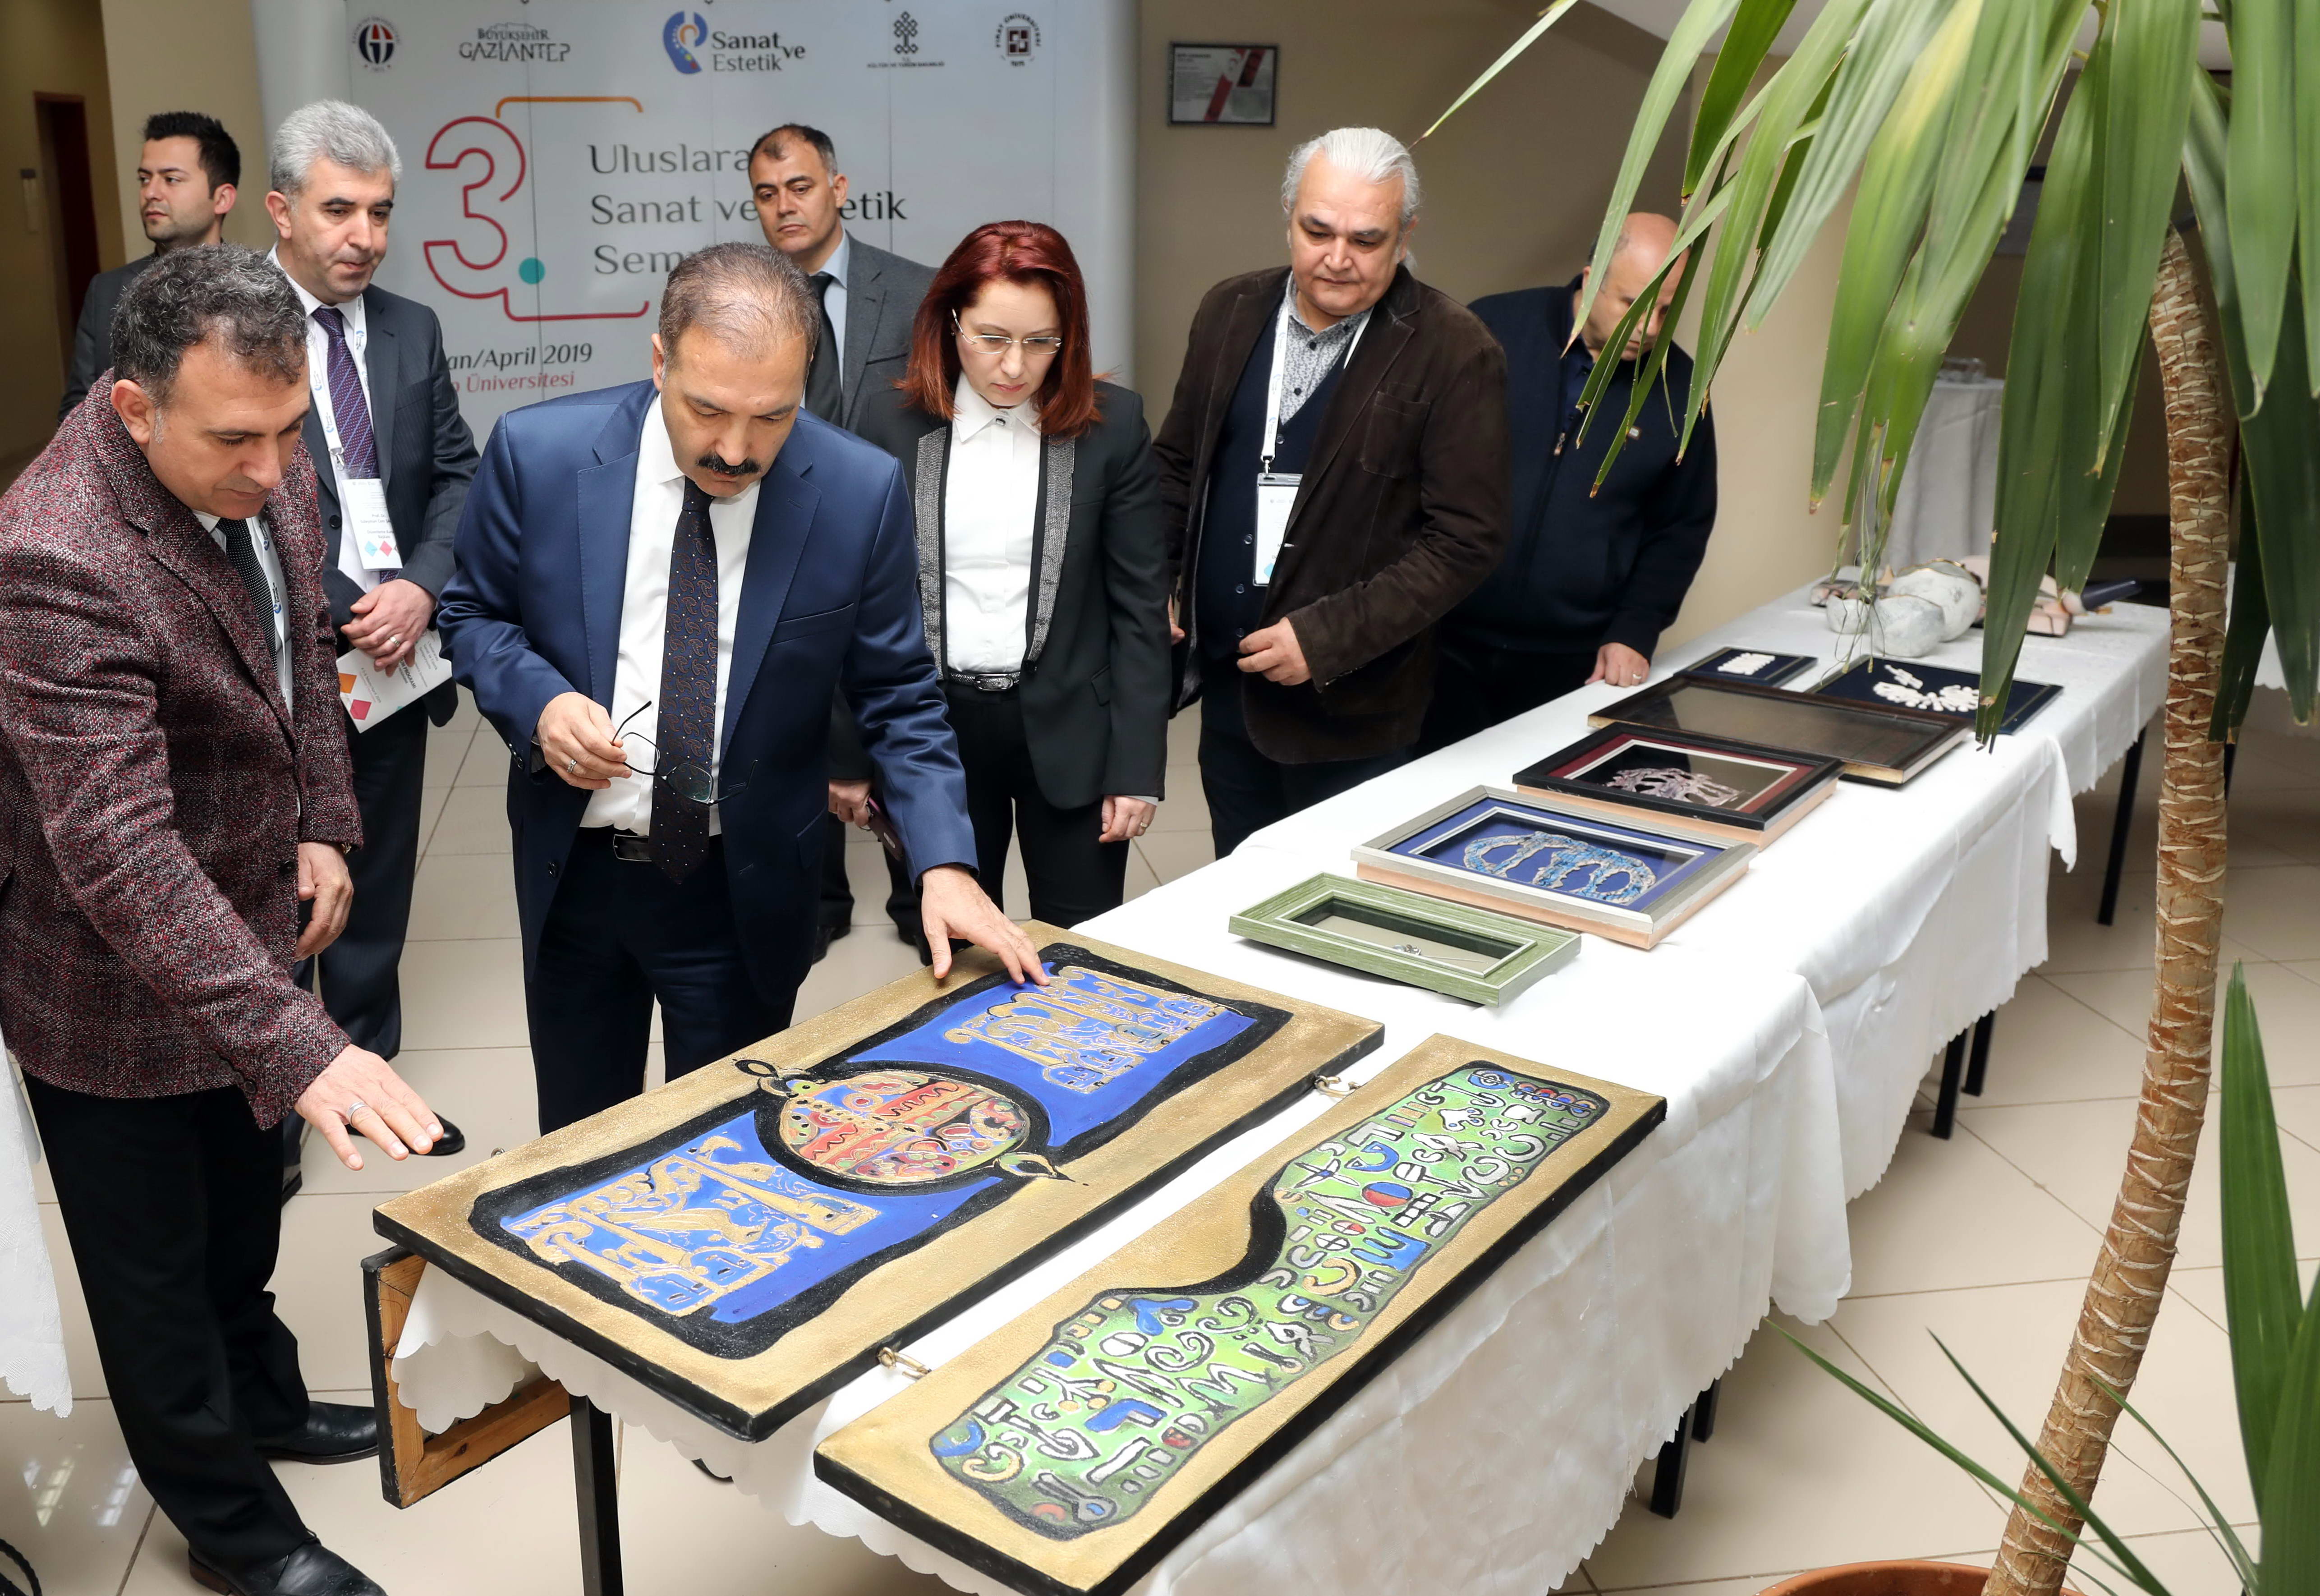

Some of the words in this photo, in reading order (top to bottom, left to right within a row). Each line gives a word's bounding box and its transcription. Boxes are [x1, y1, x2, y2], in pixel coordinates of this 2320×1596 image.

[712, 31, 780, 50] Sanat
[781, 46, 806, 59] ve
[712, 53, 782, 71] Estetik
[587, 143, 751, 174] Uluslara
[591, 194, 703, 225] Sanat
[714, 199, 760, 221] ve
[839, 191, 907, 220] etik
[594, 244, 684, 275] Sem
[447, 345, 536, 372] an/April
[544, 342, 593, 363] 2019
[467, 371, 575, 393] Üniversitesi
